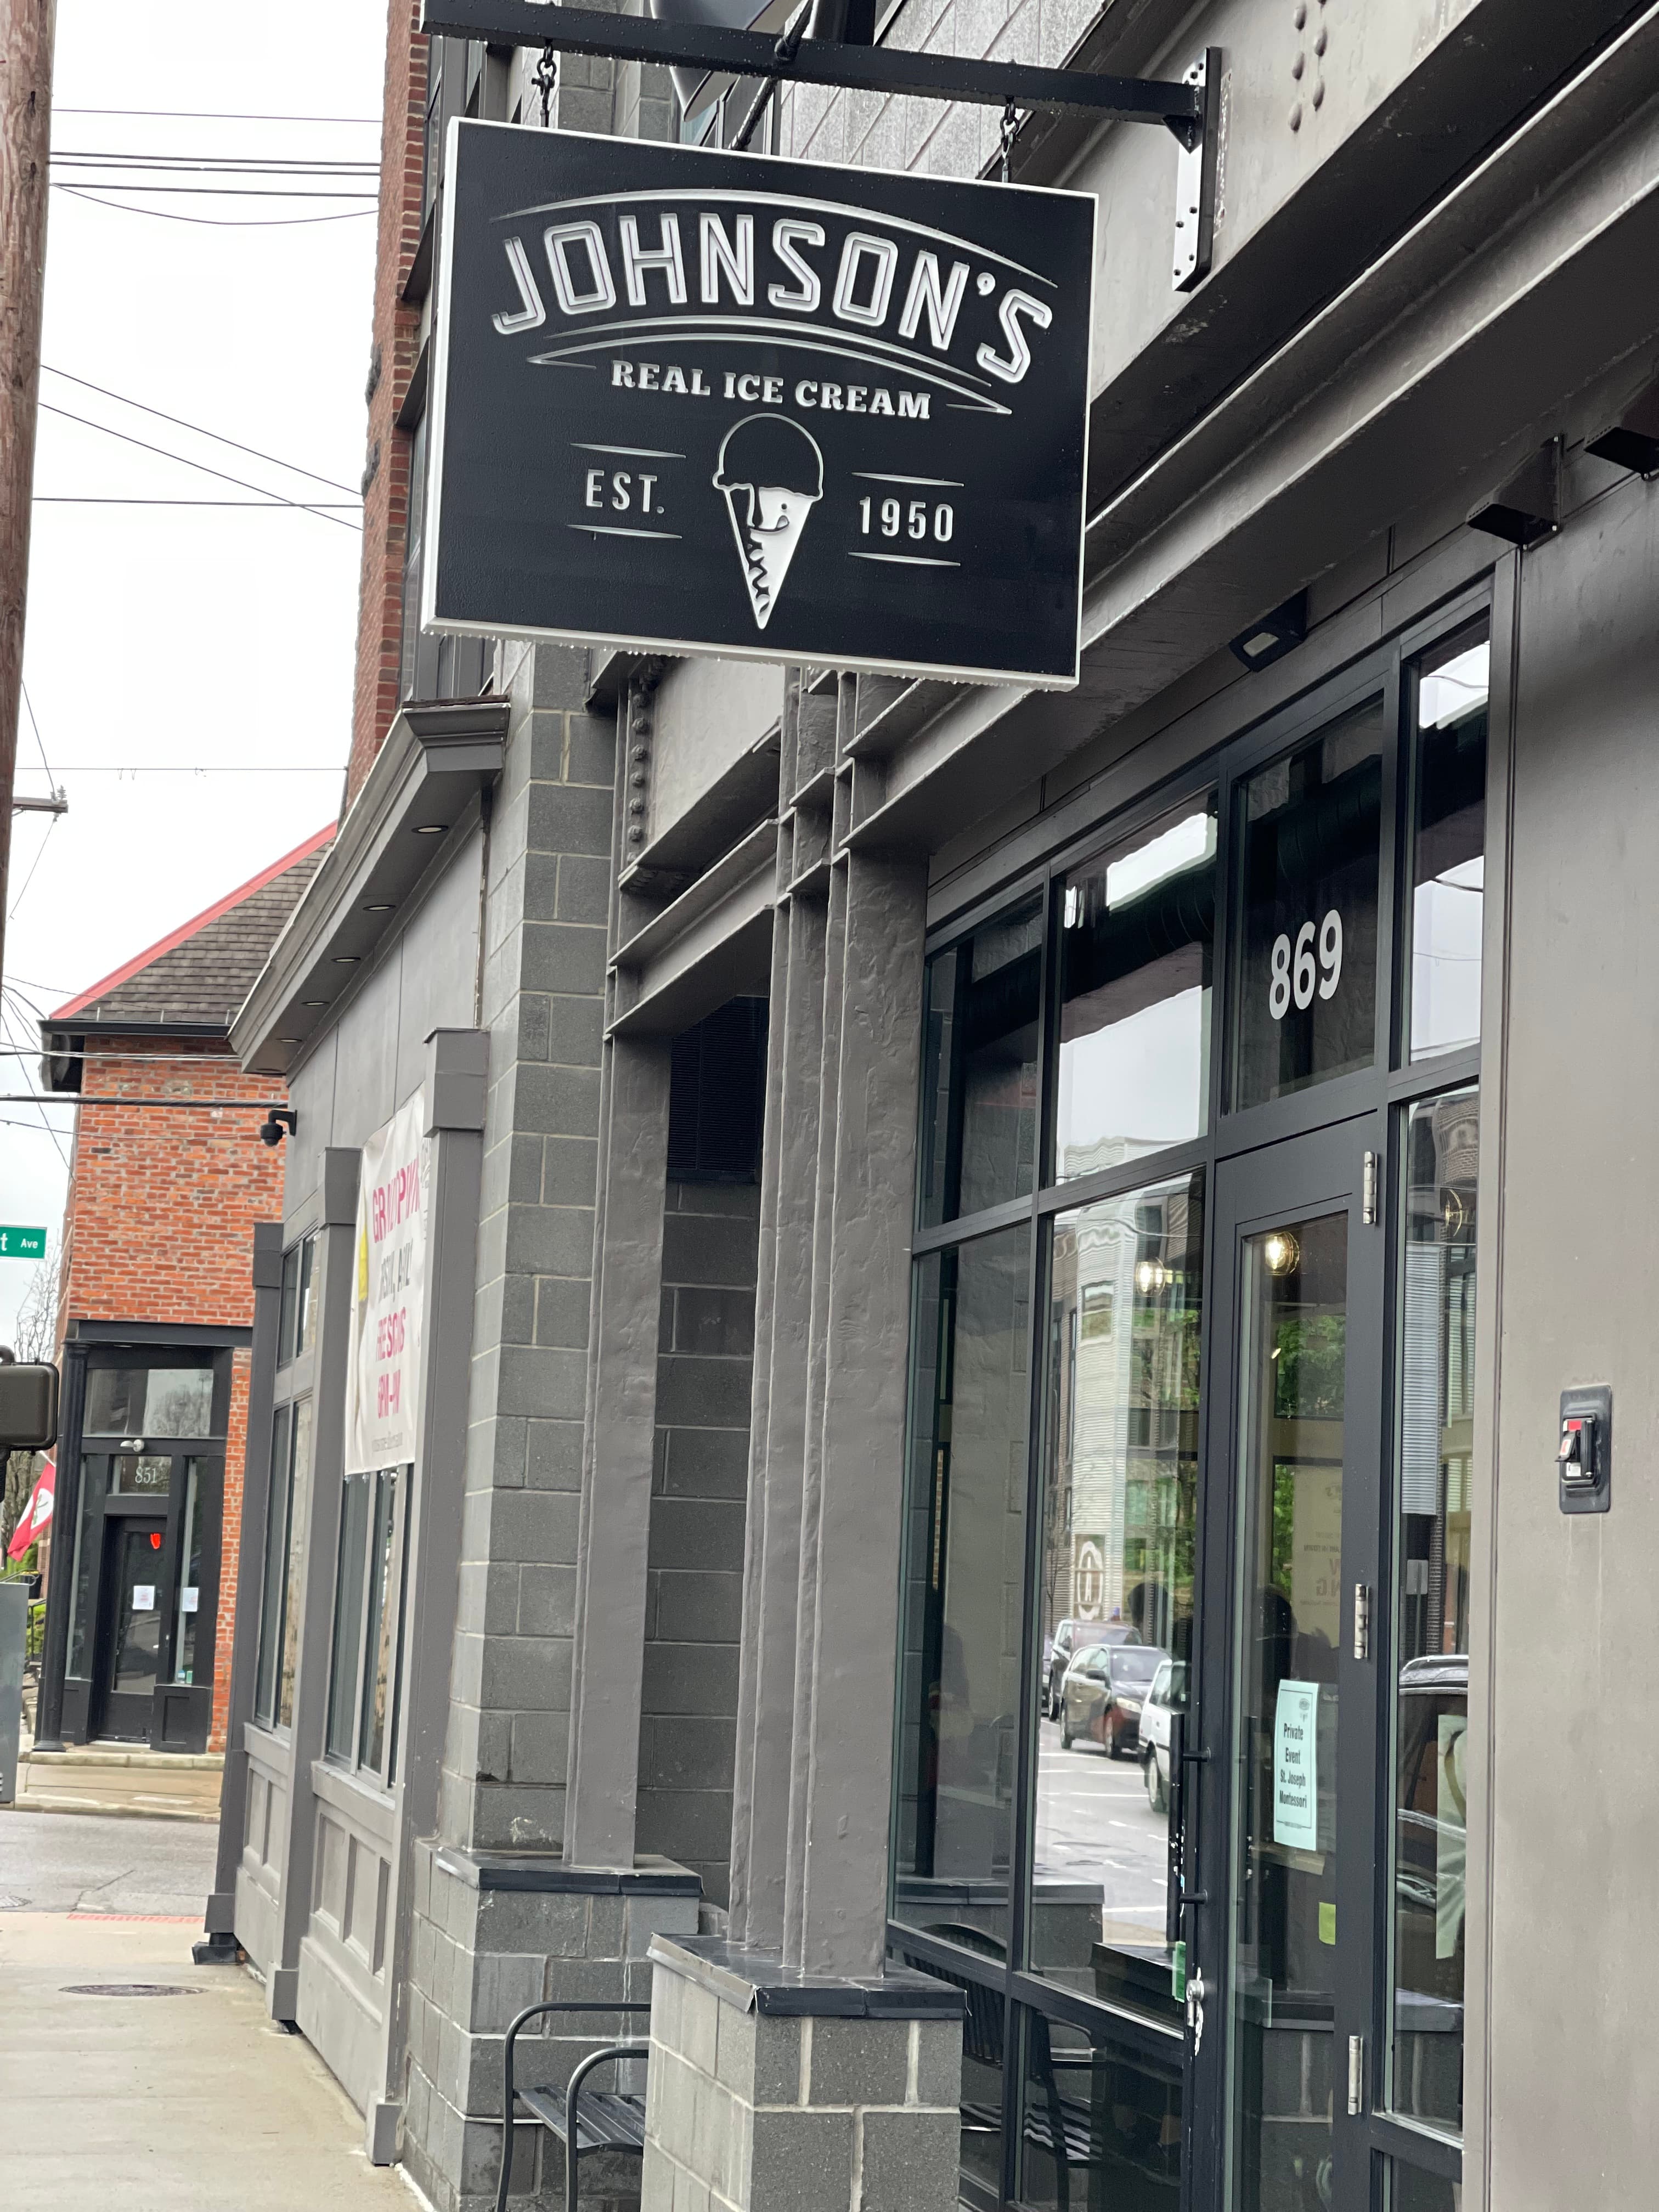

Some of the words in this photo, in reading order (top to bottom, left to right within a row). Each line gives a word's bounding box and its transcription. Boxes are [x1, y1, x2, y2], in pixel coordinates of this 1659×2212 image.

[492, 213, 1053, 383] JOHNSON'S
[612, 360, 710, 396] REAL
[723, 371, 784, 404] ICE
[795, 380, 932, 420] CREAM
[585, 469, 665, 515] EST.
[859, 496, 954, 543] 1950
[1269, 909, 1343, 1020] 869
[20, 1238, 38, 1249] Ave
[135, 1466, 157, 1483] 851
[1283, 1723, 1304, 1741] Private
[1285, 1747, 1301, 1765] Event
[1288, 1771, 1306, 1789] Joseph
[1279, 1790, 1307, 1809] Montessori
